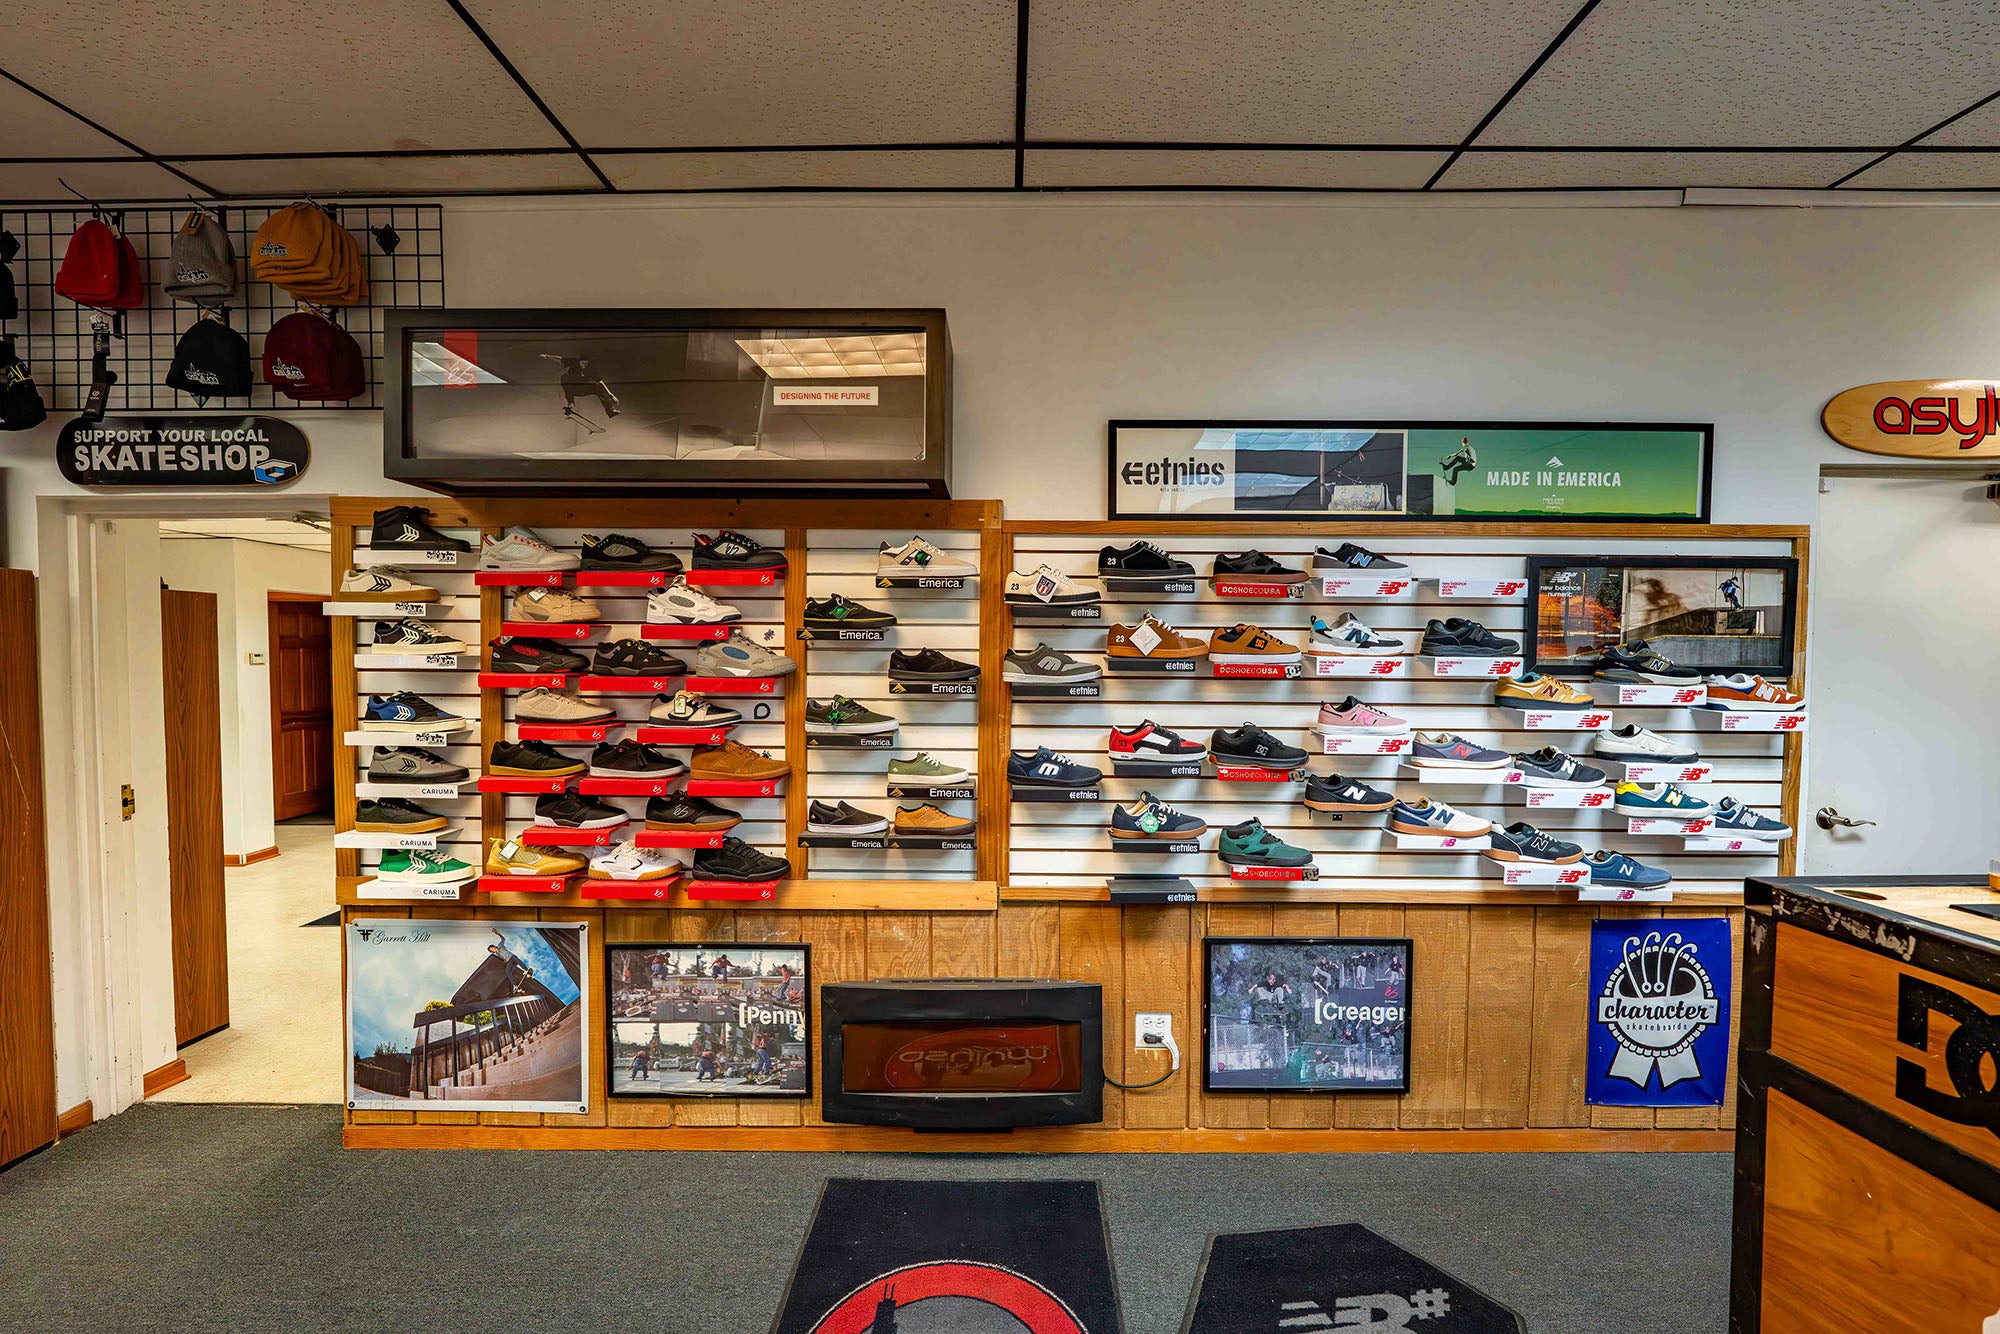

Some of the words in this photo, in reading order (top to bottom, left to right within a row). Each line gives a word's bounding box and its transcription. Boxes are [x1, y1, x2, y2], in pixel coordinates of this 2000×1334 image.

[780, 392, 821, 400] DESIGNING
[823, 392, 838, 400] THE
[840, 392, 871, 400] FUTURE
[74, 430, 152, 443] SUPPORT
[157, 430, 205, 443] YOUR
[211, 430, 269, 443] LOCAL
[74, 444, 270, 471] SKATESHOP
[1145, 457, 1225, 486] etnies
[1487, 472, 1529, 486] MADE
[1537, 472, 1552, 486] IN
[1558, 472, 1621, 487] EMERICA
[373, 930, 406, 945] Garrett
[409, 930, 432, 943] Hill
[1604, 999, 1709, 1021] character
[1627, 1023, 1687, 1031] skateboards
